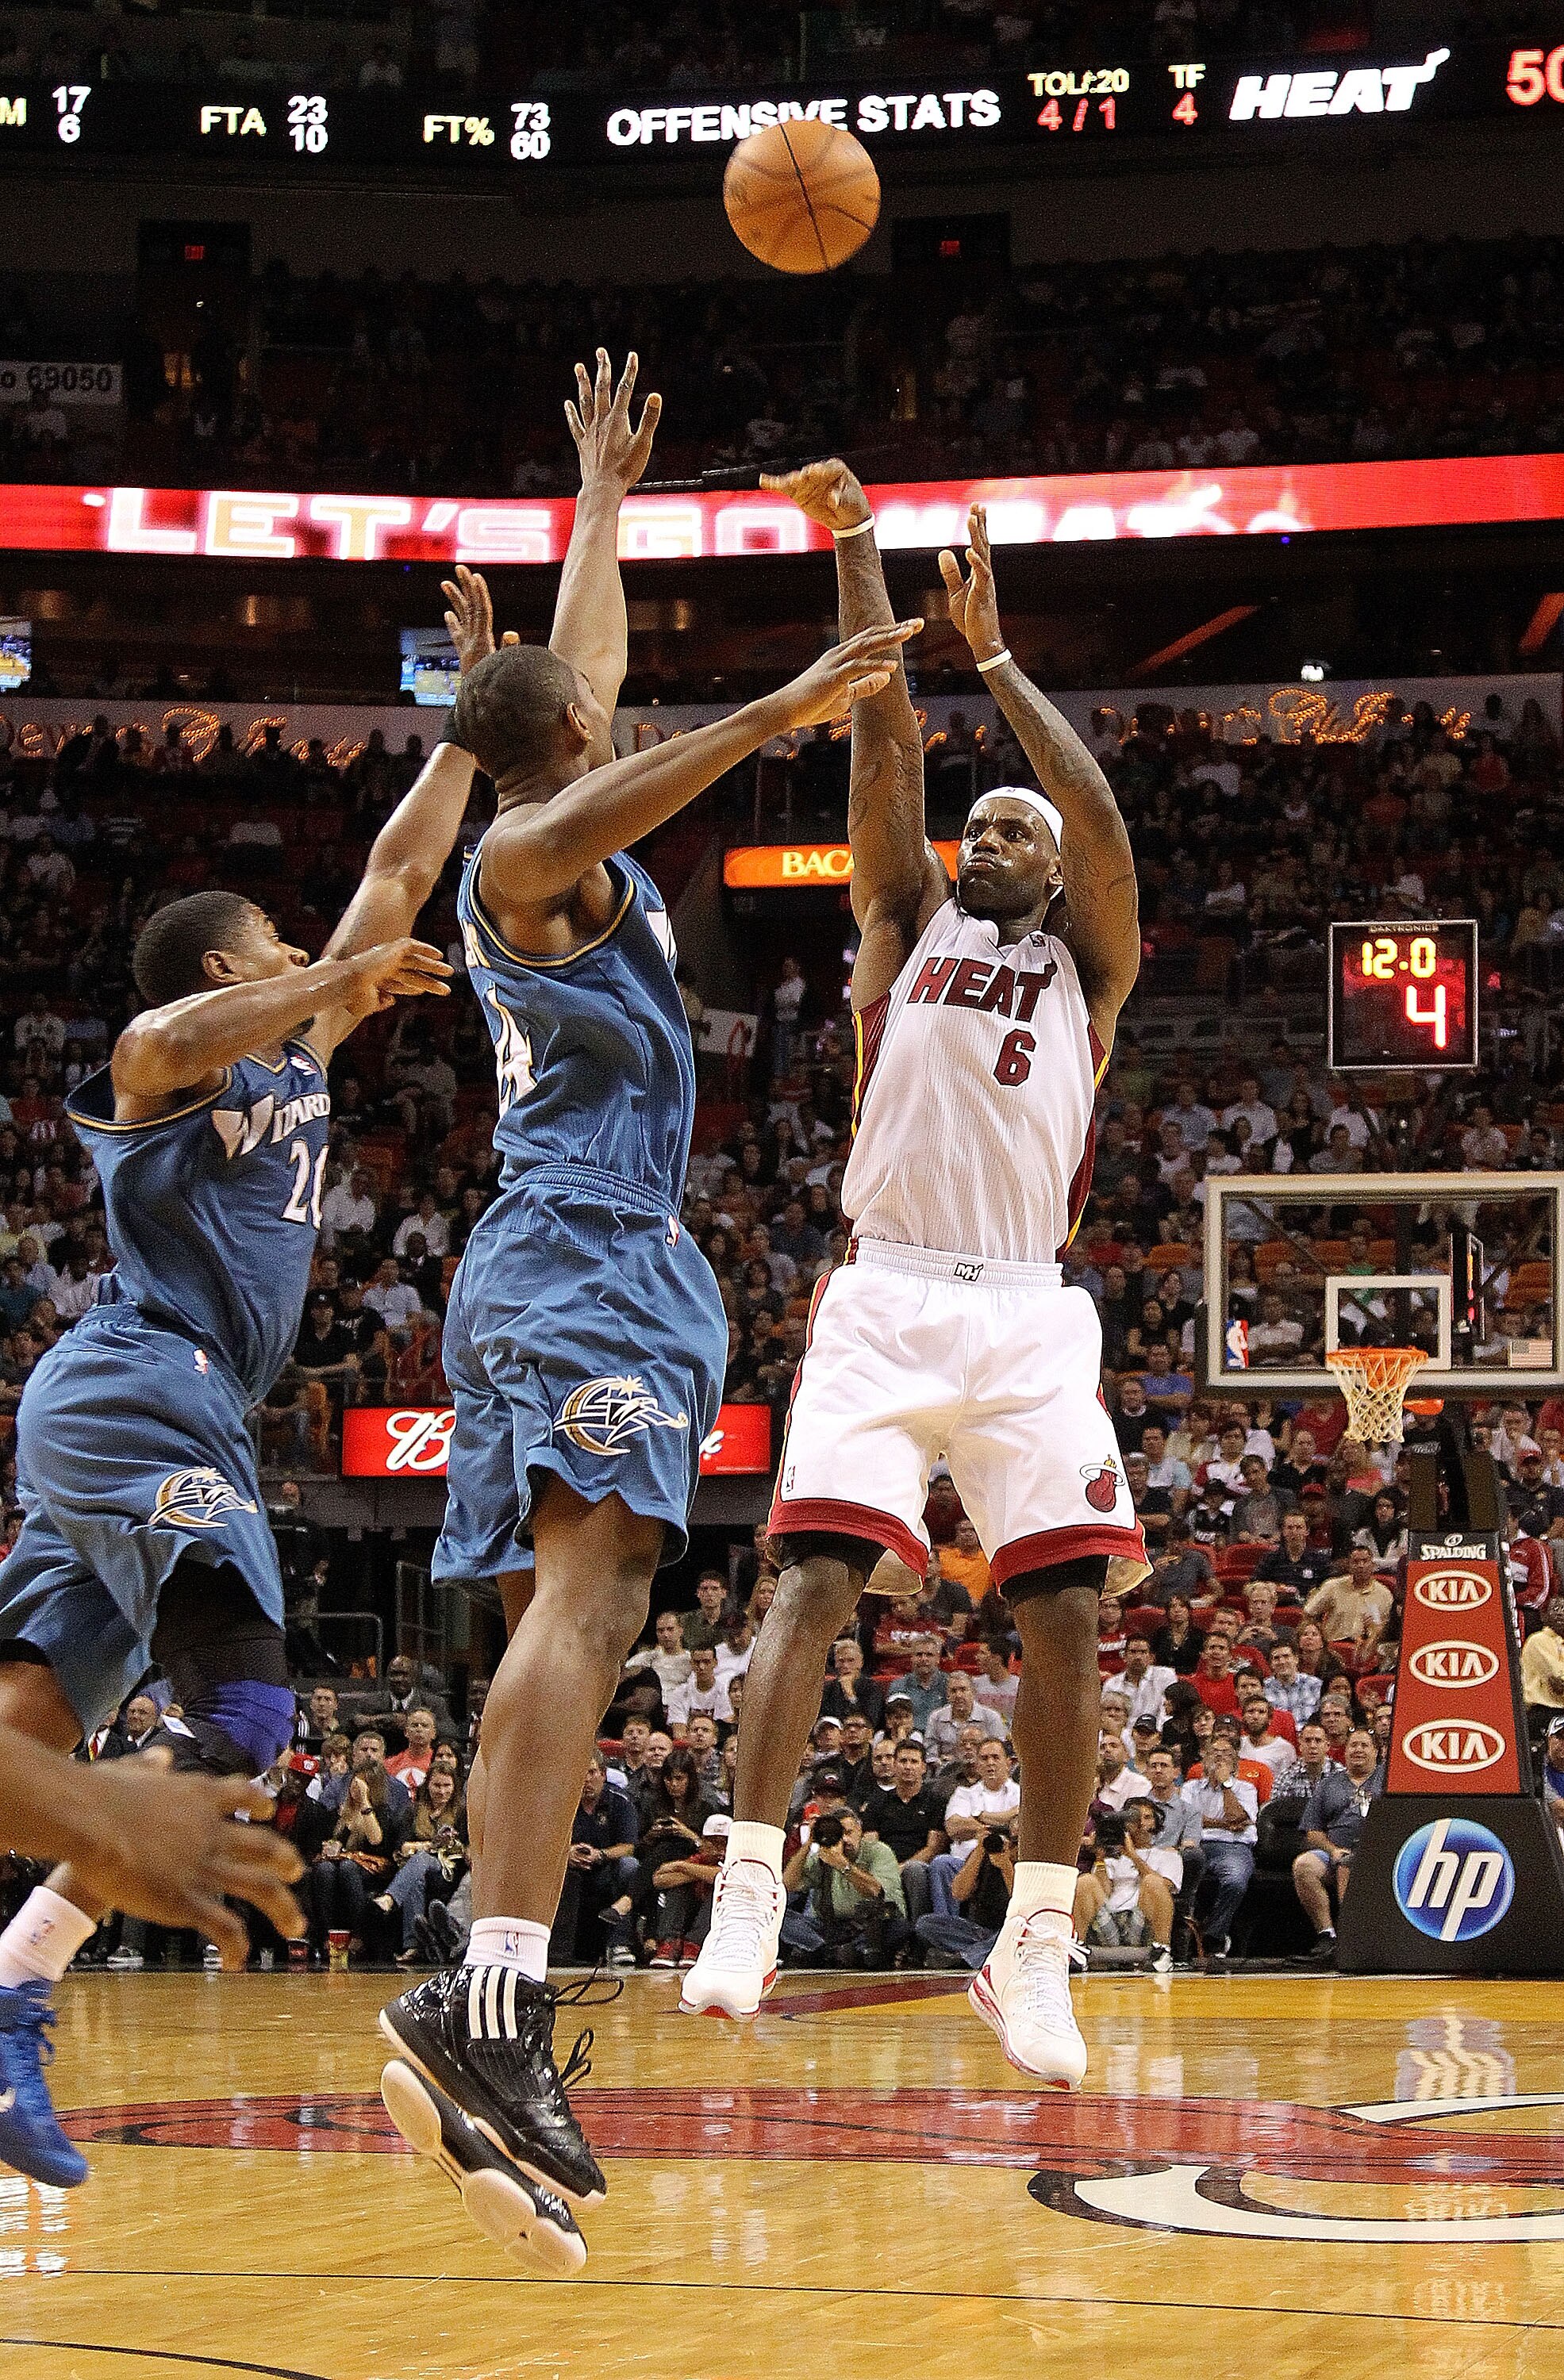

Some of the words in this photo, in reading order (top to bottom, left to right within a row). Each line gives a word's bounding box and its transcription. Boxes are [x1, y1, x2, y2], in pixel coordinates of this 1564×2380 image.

[1168, 64, 1206, 88] TF
[1228, 48, 1451, 121] HEAT
[52, 86, 91, 114] 17
[287, 96, 328, 125] 23
[857, 90, 1001, 133] STATS
[1172, 93, 1197, 125] 4
[57, 114, 80, 143] 6
[200, 106, 267, 136] FTA
[423, 115, 495, 146] FT%
[510, 102, 551, 131] 73
[288, 125, 329, 153] 10
[510, 131, 551, 159] 60
[108, 488, 551, 563] LET'S
[1362, 937, 1437, 979] 12.0
[906, 956, 1059, 1023] HEAT
[1405, 985, 1447, 1049] 4
[993, 1028, 1036, 1087] 6
[1420, 1543, 1487, 1561] SPALDING
[1428, 1580, 1481, 1602] KIA
[1424, 1652, 1485, 1677] KIA
[1421, 1732, 1489, 1760] KIA
[1406, 1818, 1504, 1942] hp
